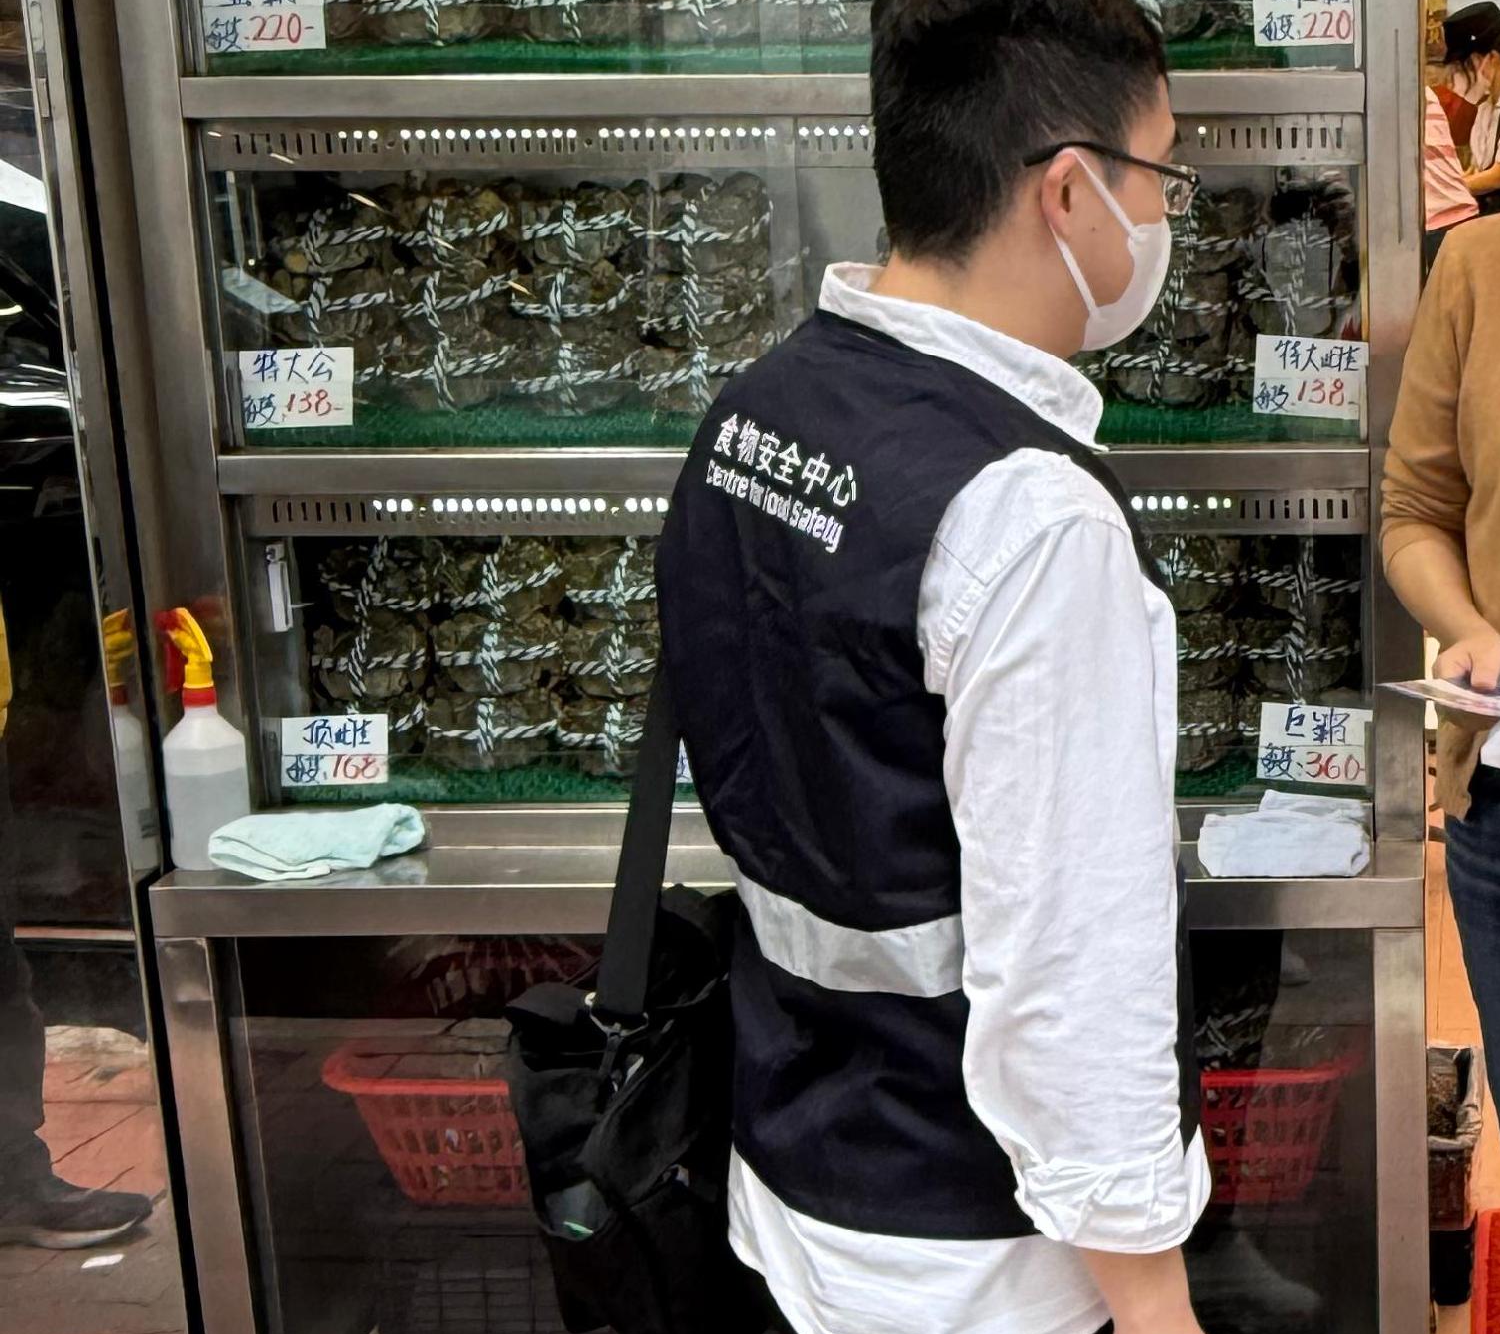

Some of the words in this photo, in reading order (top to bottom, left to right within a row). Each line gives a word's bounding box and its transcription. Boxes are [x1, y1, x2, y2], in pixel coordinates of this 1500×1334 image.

[713, 413, 857, 508] 食物安全中心
[789, 499, 844, 554] Safety
